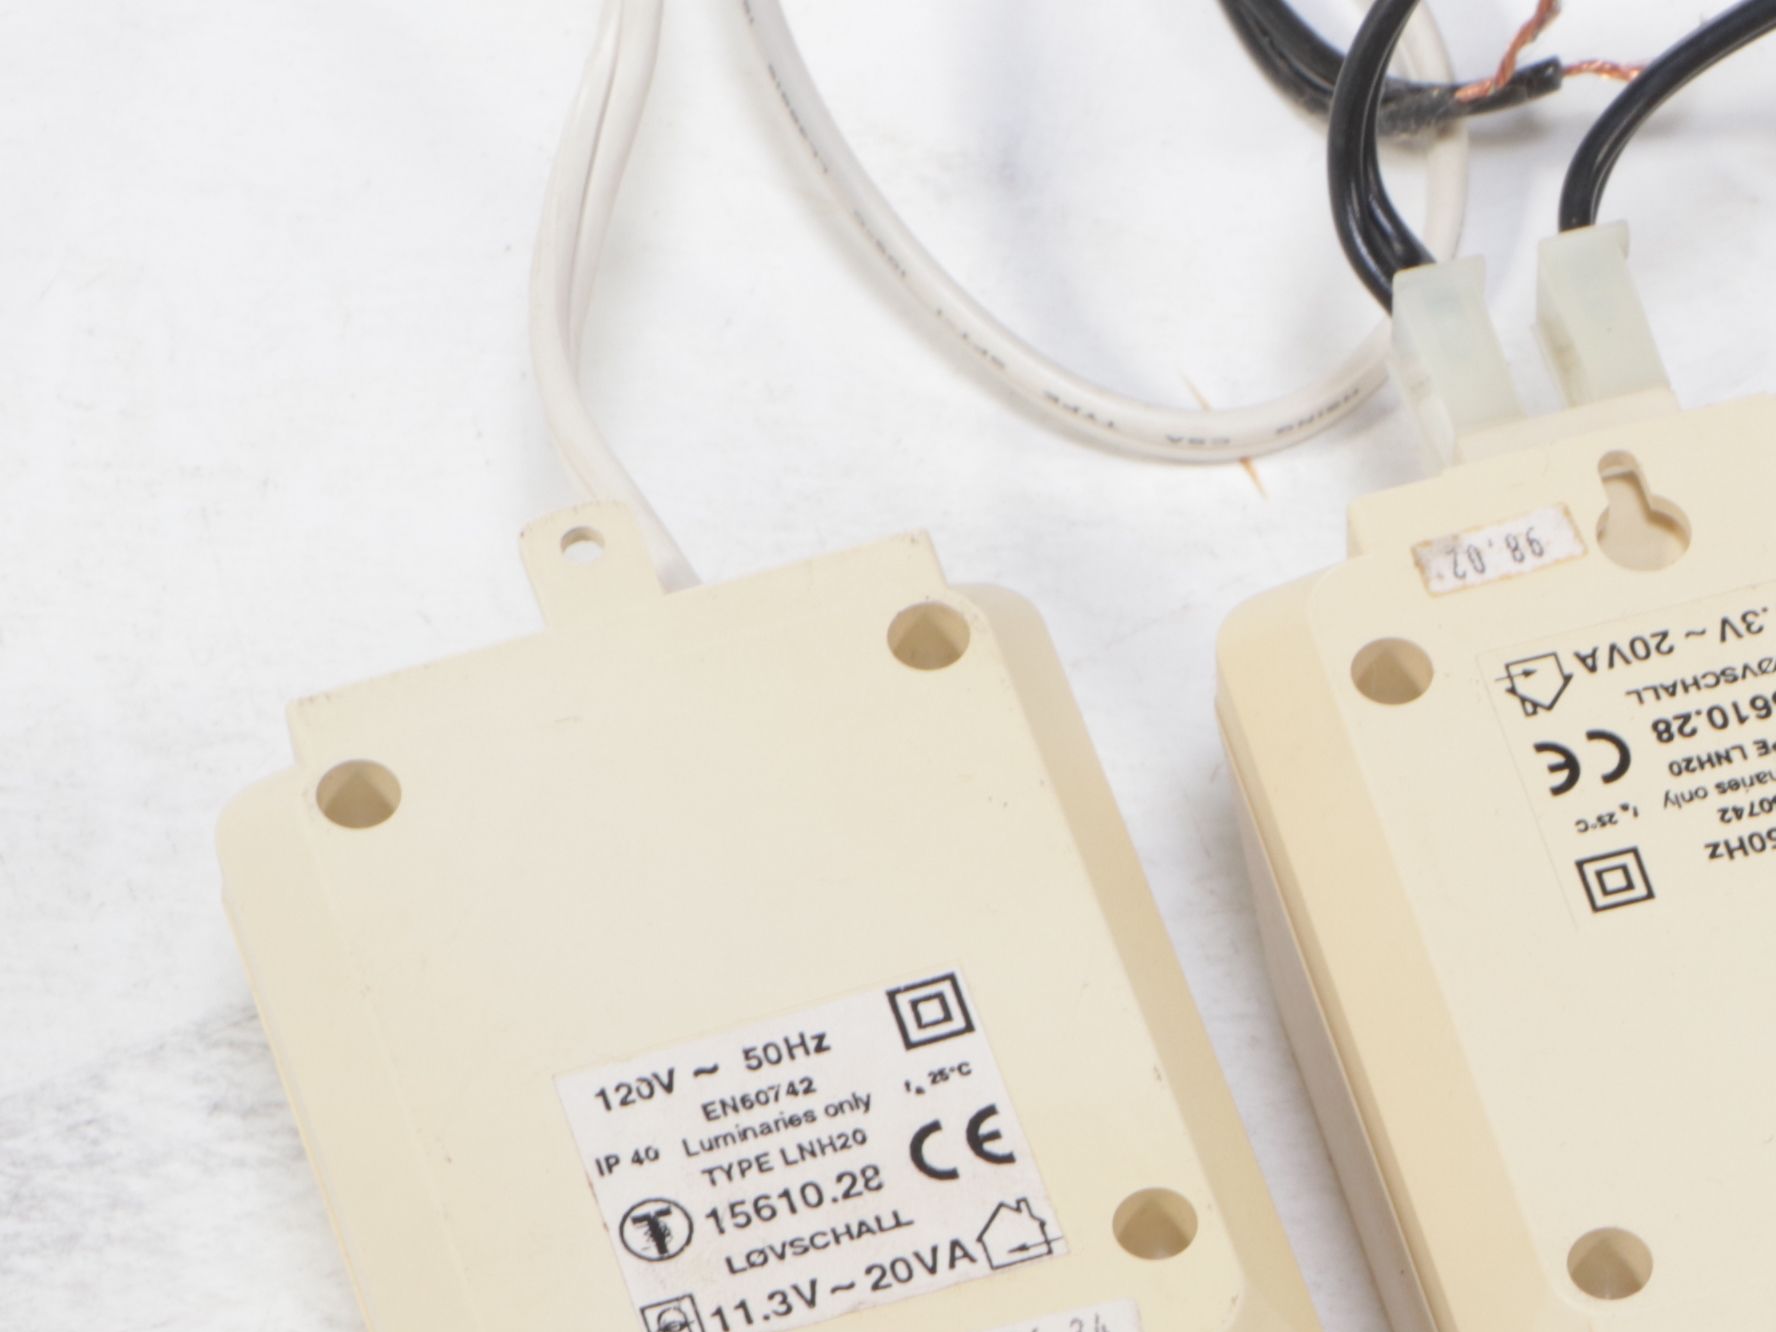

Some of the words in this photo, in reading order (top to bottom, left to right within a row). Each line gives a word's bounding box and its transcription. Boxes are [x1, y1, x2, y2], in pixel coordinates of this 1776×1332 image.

[1574, 631, 1674, 673] 20VA
[1669, 745, 1747, 776] LNH20
[1664, 787, 1708, 808] only
[596, 1068, 674, 1111] 120V
[743, 1033, 830, 1070] 50Hz
[702, 1077, 816, 1121] EN60742
[682, 1110, 817, 1157] Luminaries
[824, 1093, 870, 1117] only
[596, 1155, 620, 1176] IP
[702, 1153, 773, 1186] TYPE
[780, 1129, 867, 1166] LNH20
[706, 1165, 883, 1234] 15610.28
[712, 1279, 817, 1332] 11.3V
[865, 1239, 977, 1291] 20VA
